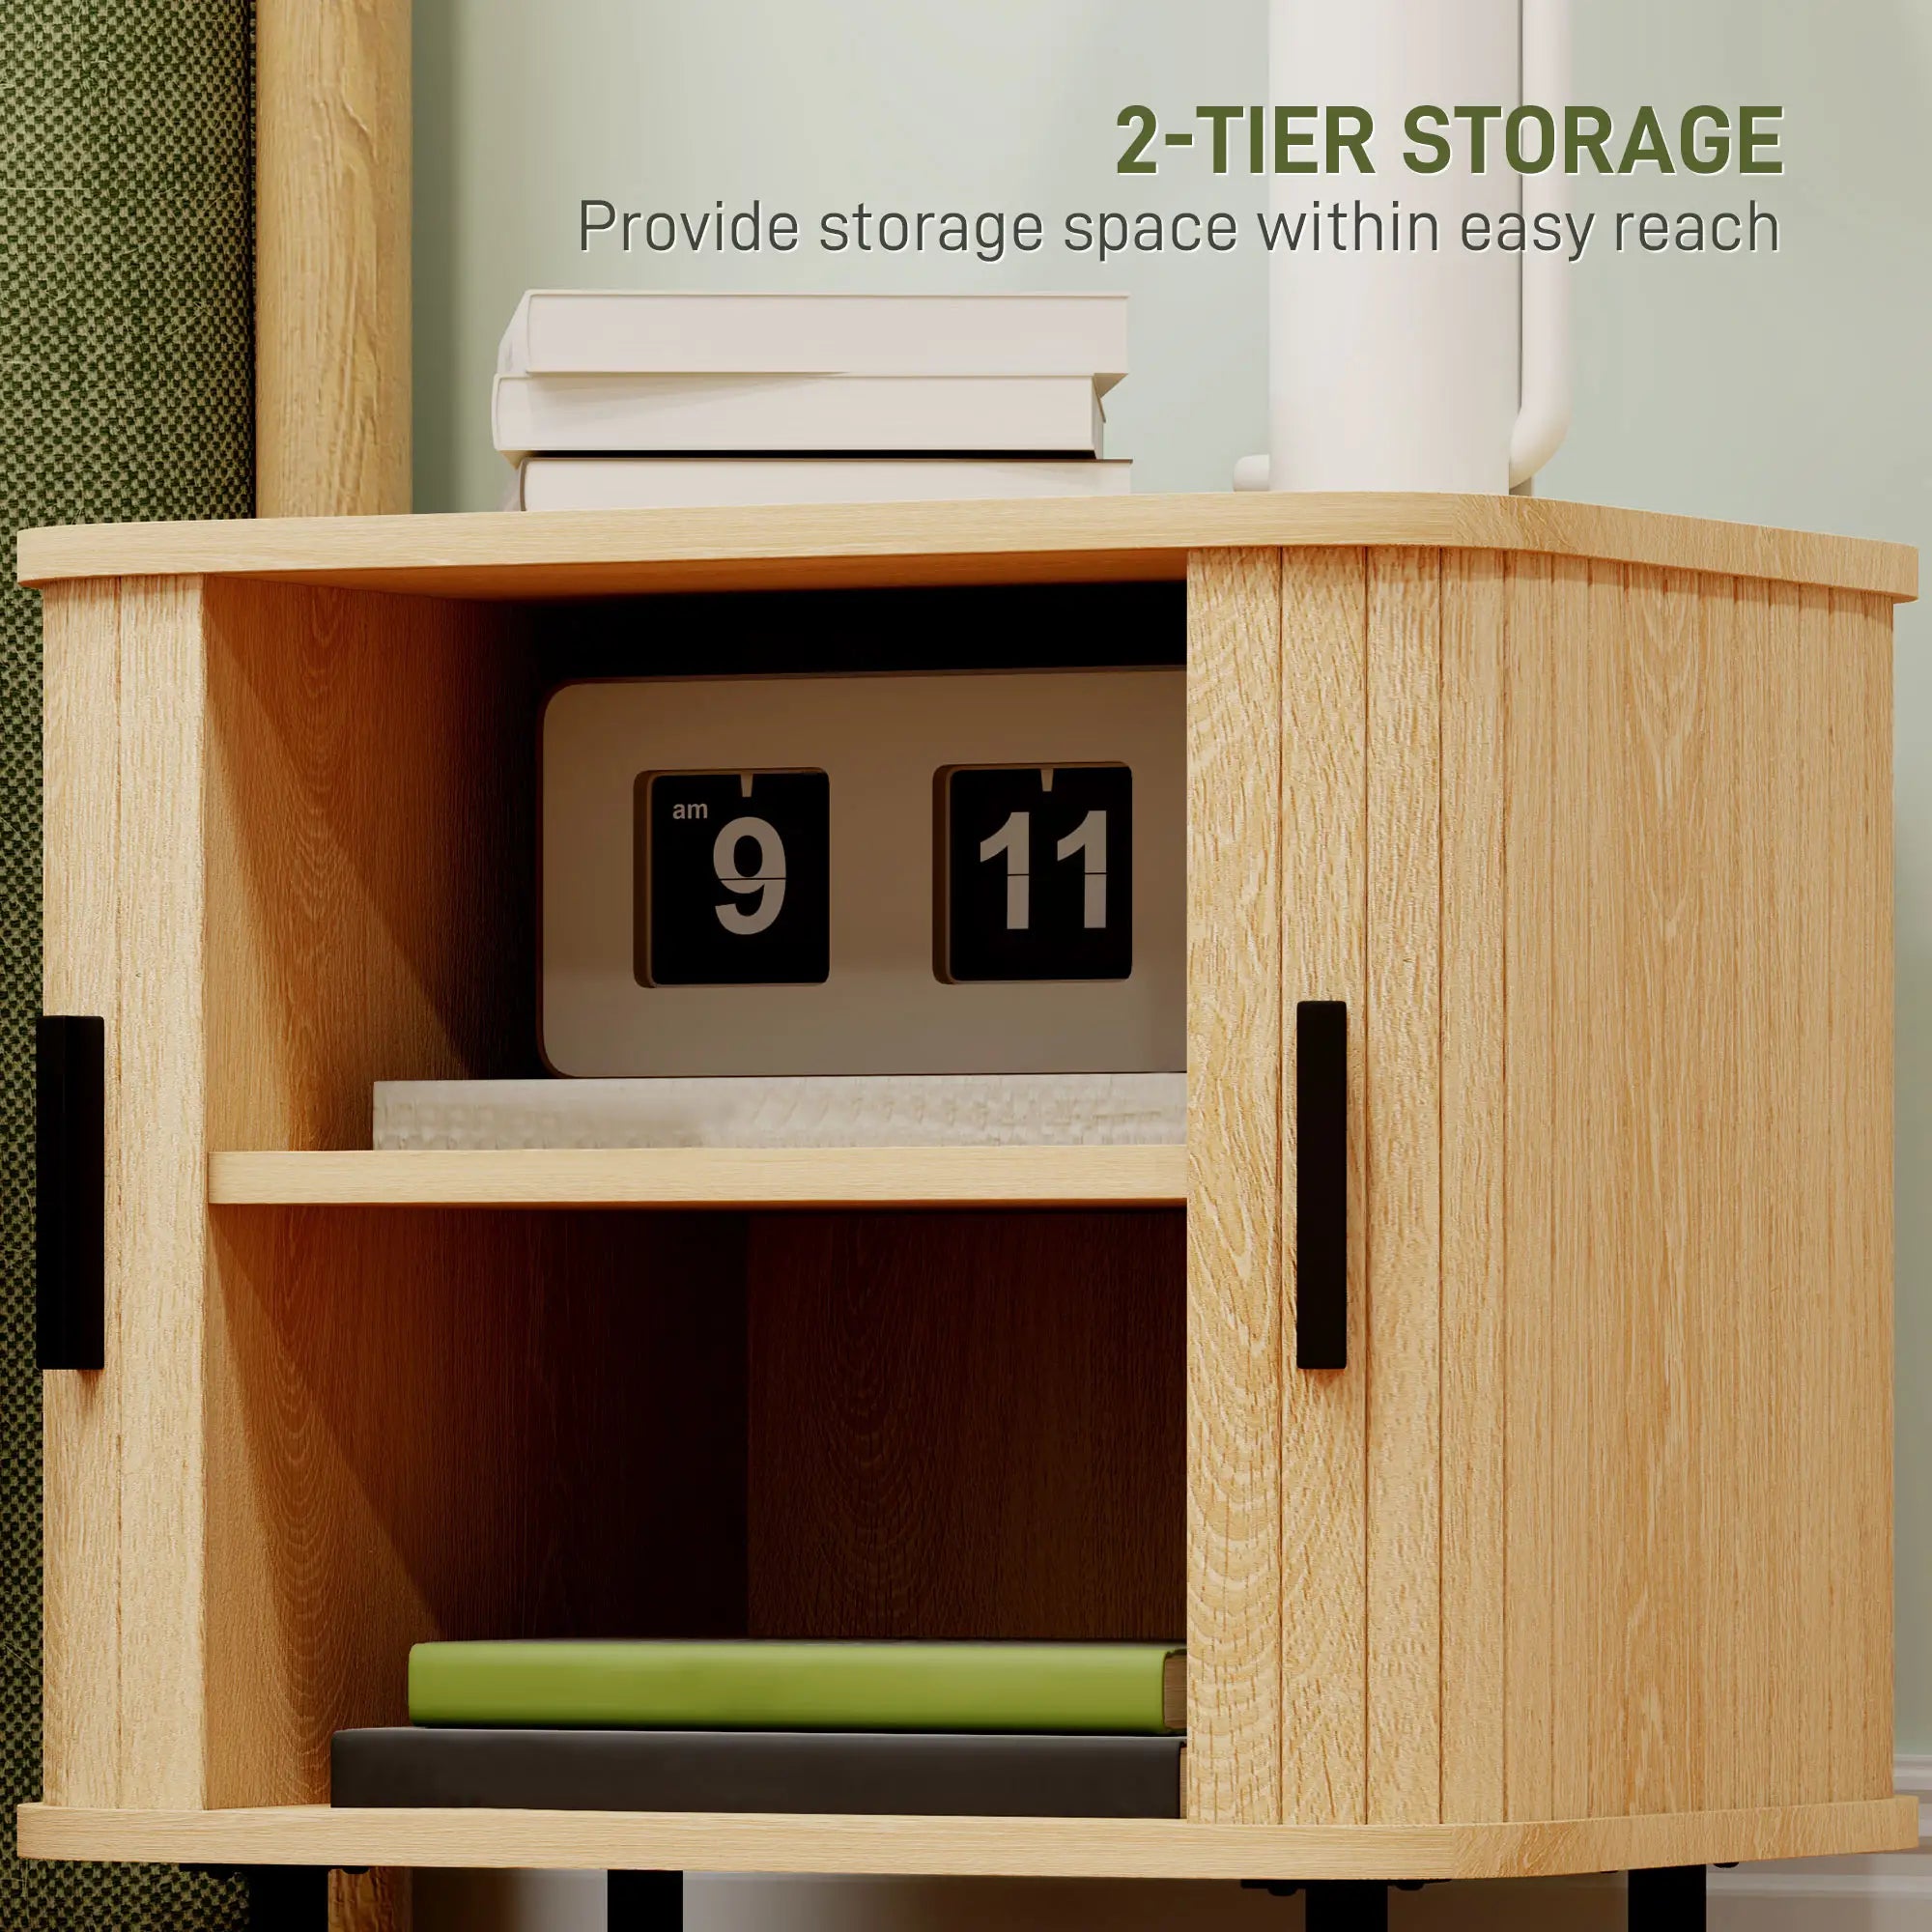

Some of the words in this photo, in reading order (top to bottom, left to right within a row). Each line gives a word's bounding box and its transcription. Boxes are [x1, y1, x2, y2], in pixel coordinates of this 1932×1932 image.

[672, 804, 708, 820] am
[980, 810, 1107, 930] 11
[713, 816, 786, 935] 9
